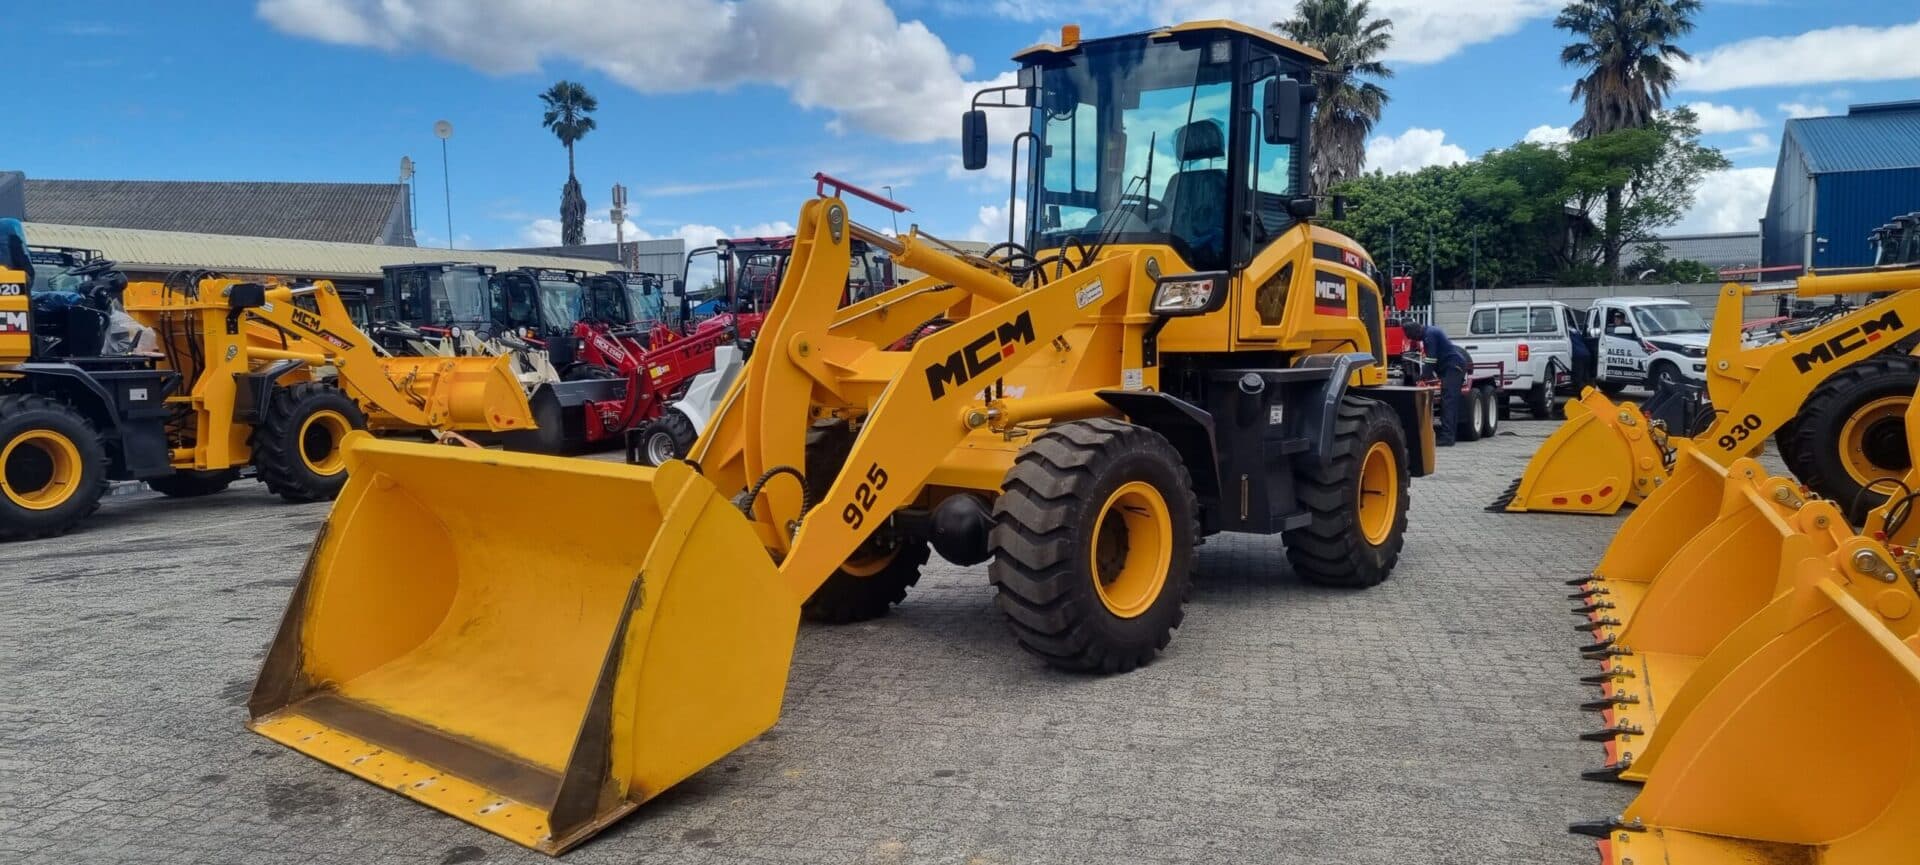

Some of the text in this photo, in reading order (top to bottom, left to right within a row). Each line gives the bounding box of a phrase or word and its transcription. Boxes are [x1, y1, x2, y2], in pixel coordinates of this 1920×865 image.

[1345, 252, 1360, 268] MCM
[0, 284, 20, 295] 20
[1315, 280, 1345, 301] MCM
[292, 308, 321, 331] MCM
[924, 309, 1036, 402] MCM
[1791, 309, 1904, 375] MCM
[1718, 413, 1762, 451] 930
[842, 461, 889, 531] 925
